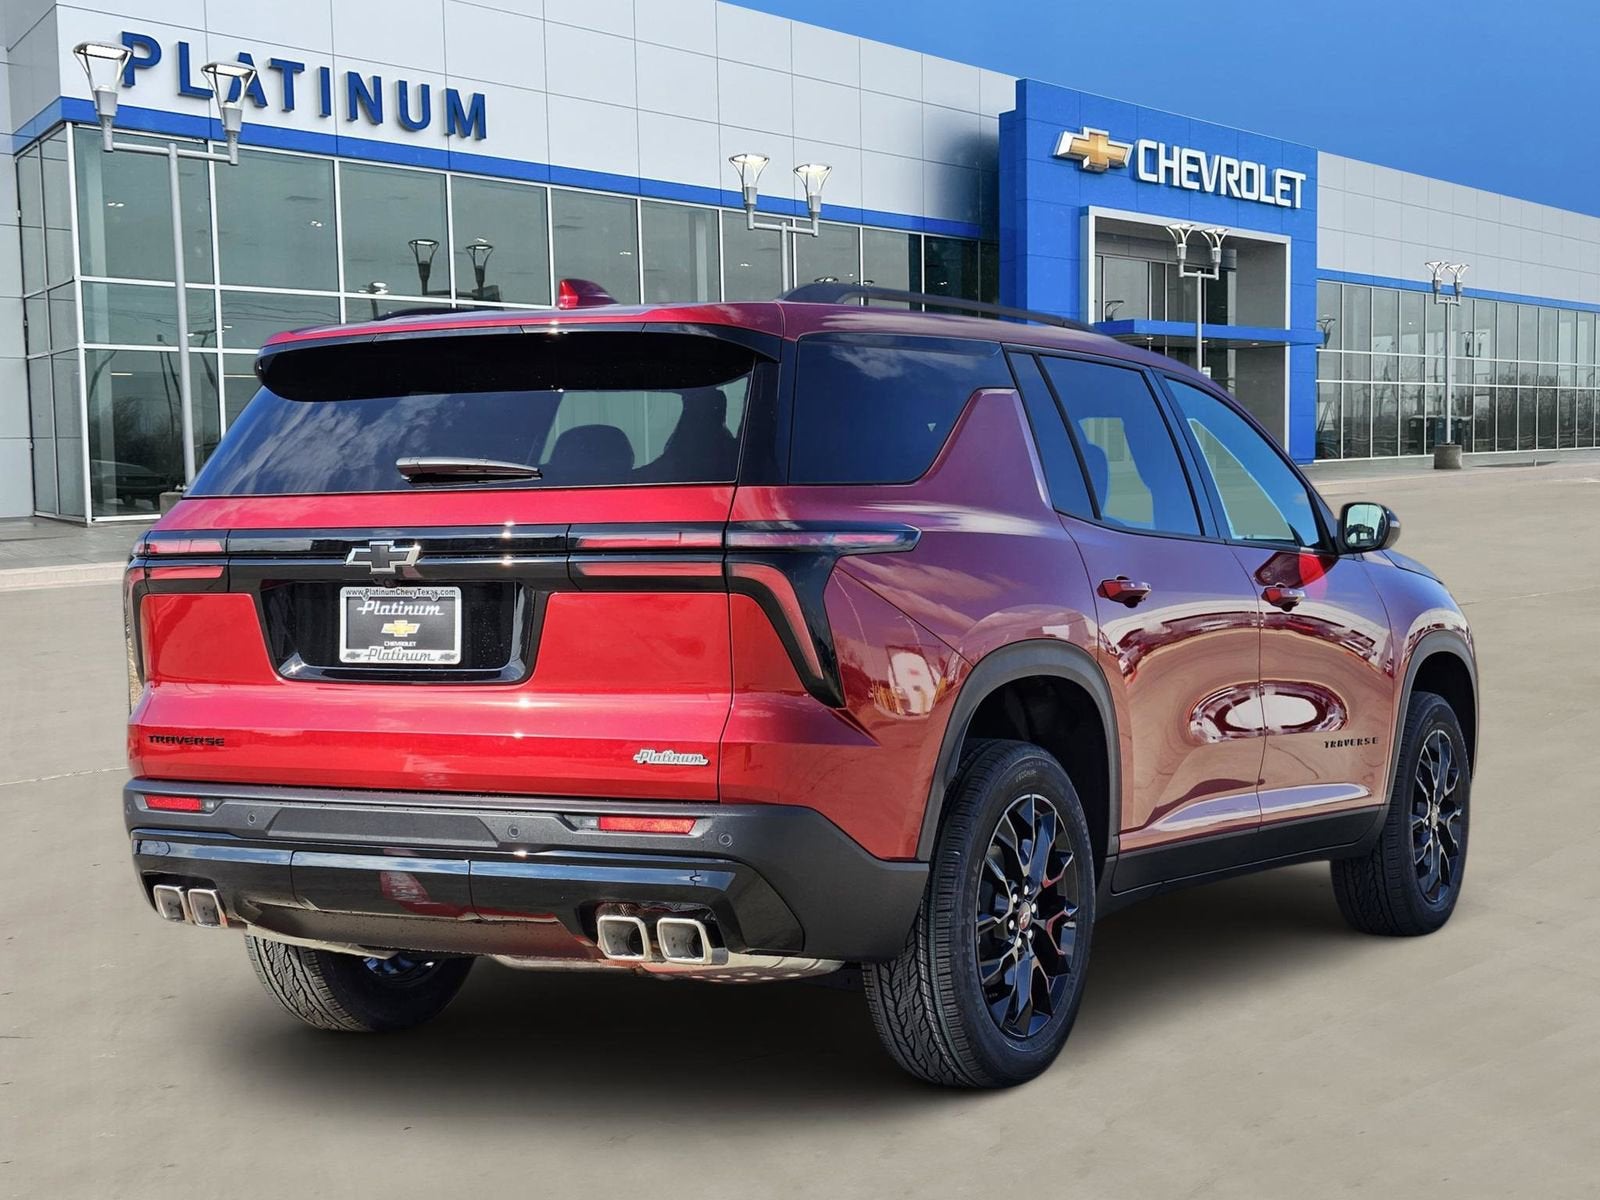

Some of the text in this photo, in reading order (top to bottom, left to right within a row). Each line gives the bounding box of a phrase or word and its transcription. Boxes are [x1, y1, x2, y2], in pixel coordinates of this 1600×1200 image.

[121, 31, 488, 140] PLATINUM
[1137, 139, 1306, 209] CHEVROLET
[357, 601, 445, 616] Platinum
[364, 648, 435, 662] Platinum
[148, 736, 225, 747] TRAVERSE
[1324, 737, 1379, 749] TRAVERSE
[633, 749, 709, 766] Platinum
